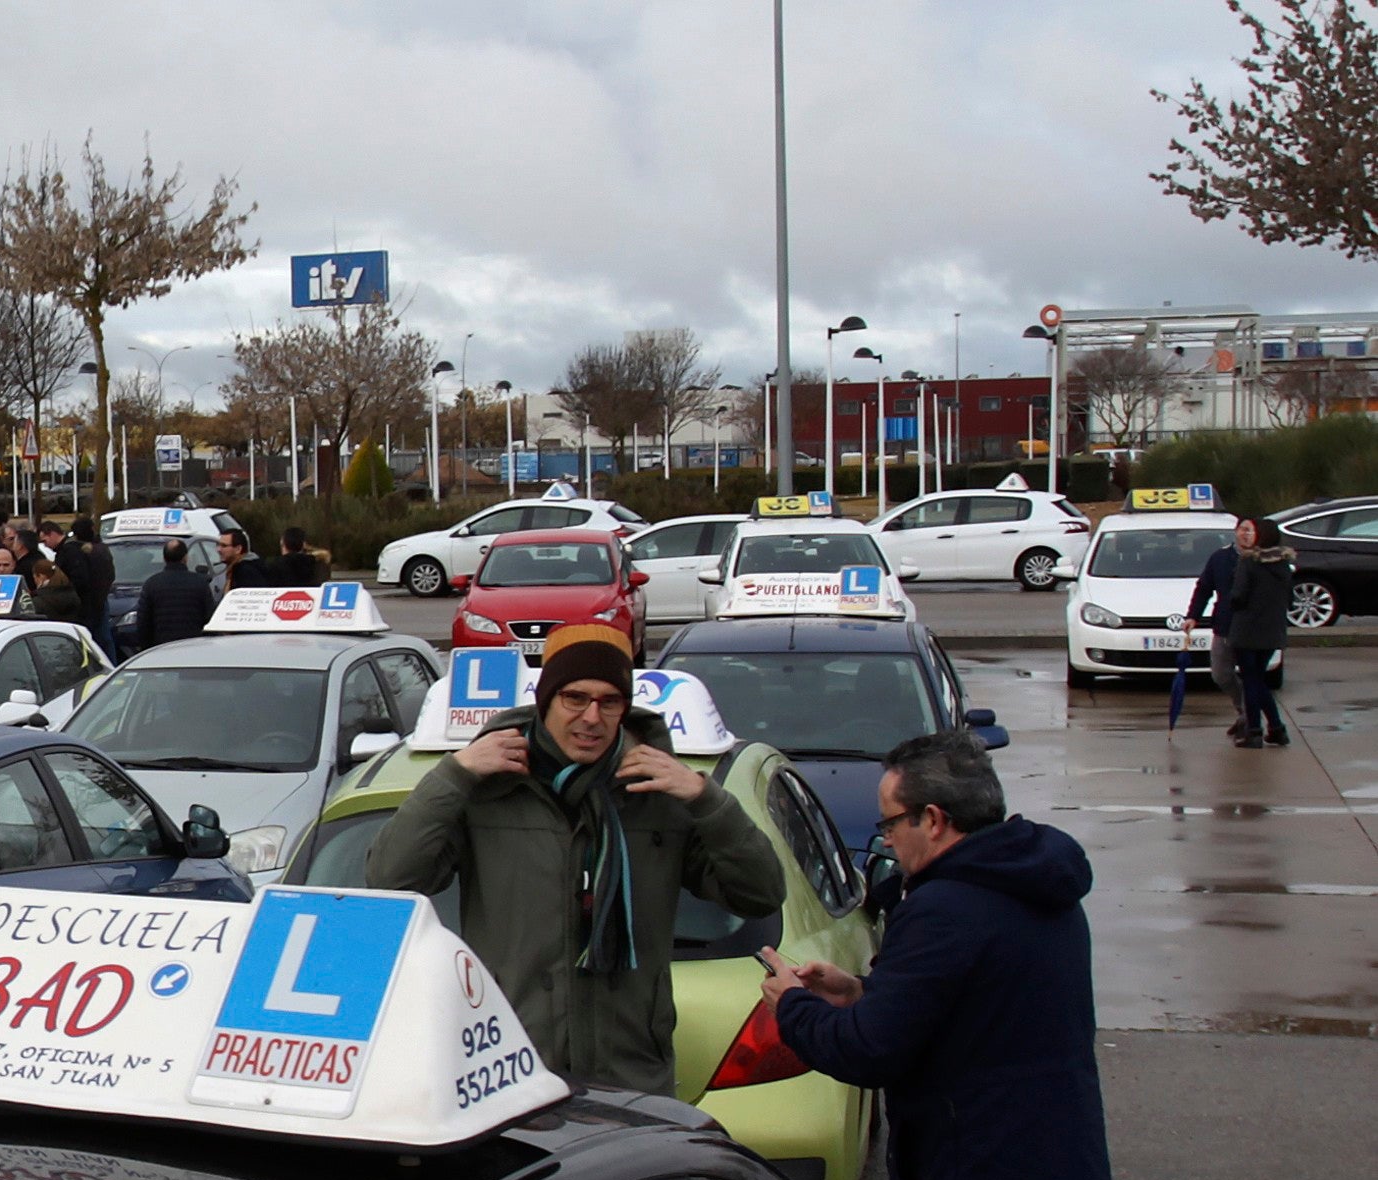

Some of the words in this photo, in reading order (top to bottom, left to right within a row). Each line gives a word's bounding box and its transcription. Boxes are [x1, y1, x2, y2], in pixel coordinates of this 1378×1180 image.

[308, 258, 364, 301] itv
[814, 494, 825, 506] L
[1195, 487, 1206, 499] L
[168, 511, 177, 522] L
[757, 584, 840, 596] PUERTOLLANO
[849, 571, 869, 592] L
[273, 600, 314, 612] FAUSTINO
[328, 587, 347, 607] L
[1153, 638, 1180, 648] 1842
[467, 659, 500, 700] L
[450, 709, 496, 726] PRACTI
[263, 913, 341, 1016] L
[461, 1015, 502, 1059] 926
[20, 1046, 116, 1068] OFICINA
[159, 1058, 175, 1074] 5
[206, 1033, 360, 1085] PRACTICAS
[0, 1063, 45, 1080] SAN
[52, 1069, 121, 1088] JUAN
[455, 1046, 534, 1110] 552270
